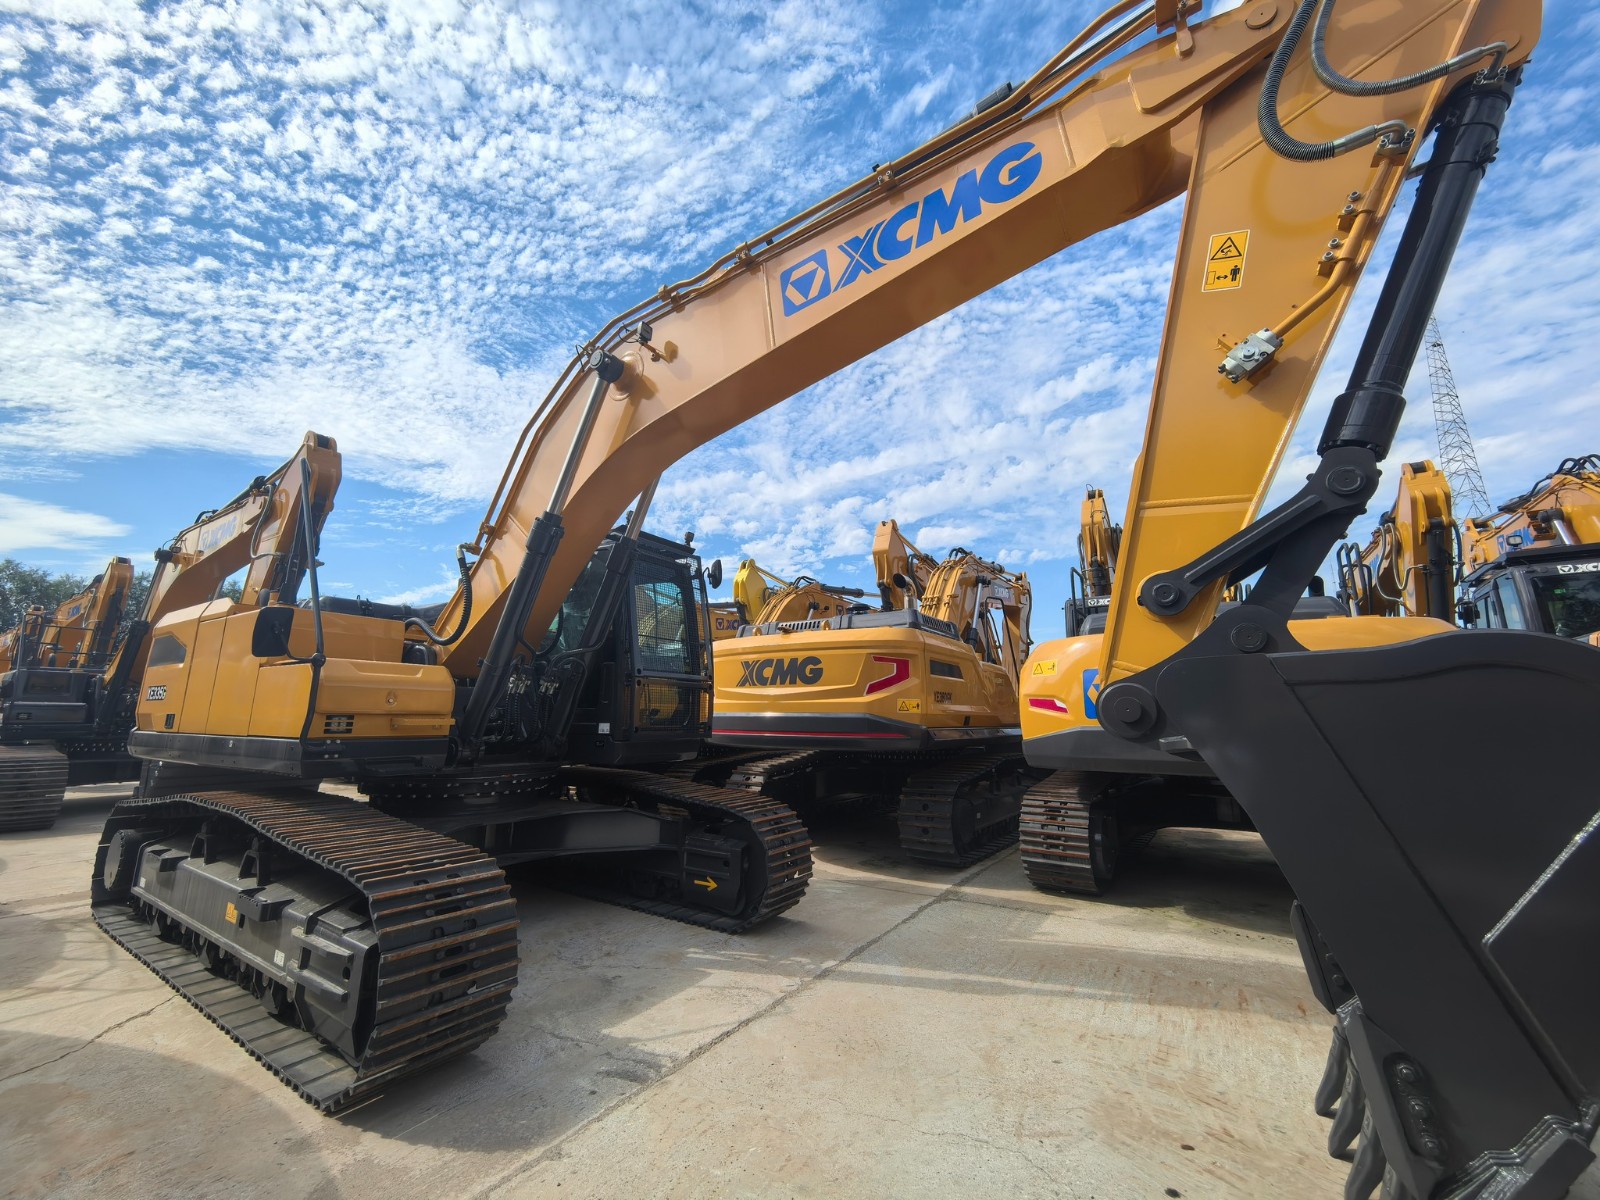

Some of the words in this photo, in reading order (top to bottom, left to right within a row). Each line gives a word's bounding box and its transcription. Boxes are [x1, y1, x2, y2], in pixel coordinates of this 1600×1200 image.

[832, 141, 1043, 294] XCMG
[1574, 562, 1600, 573] XC
[736, 655, 824, 688] XCMG
